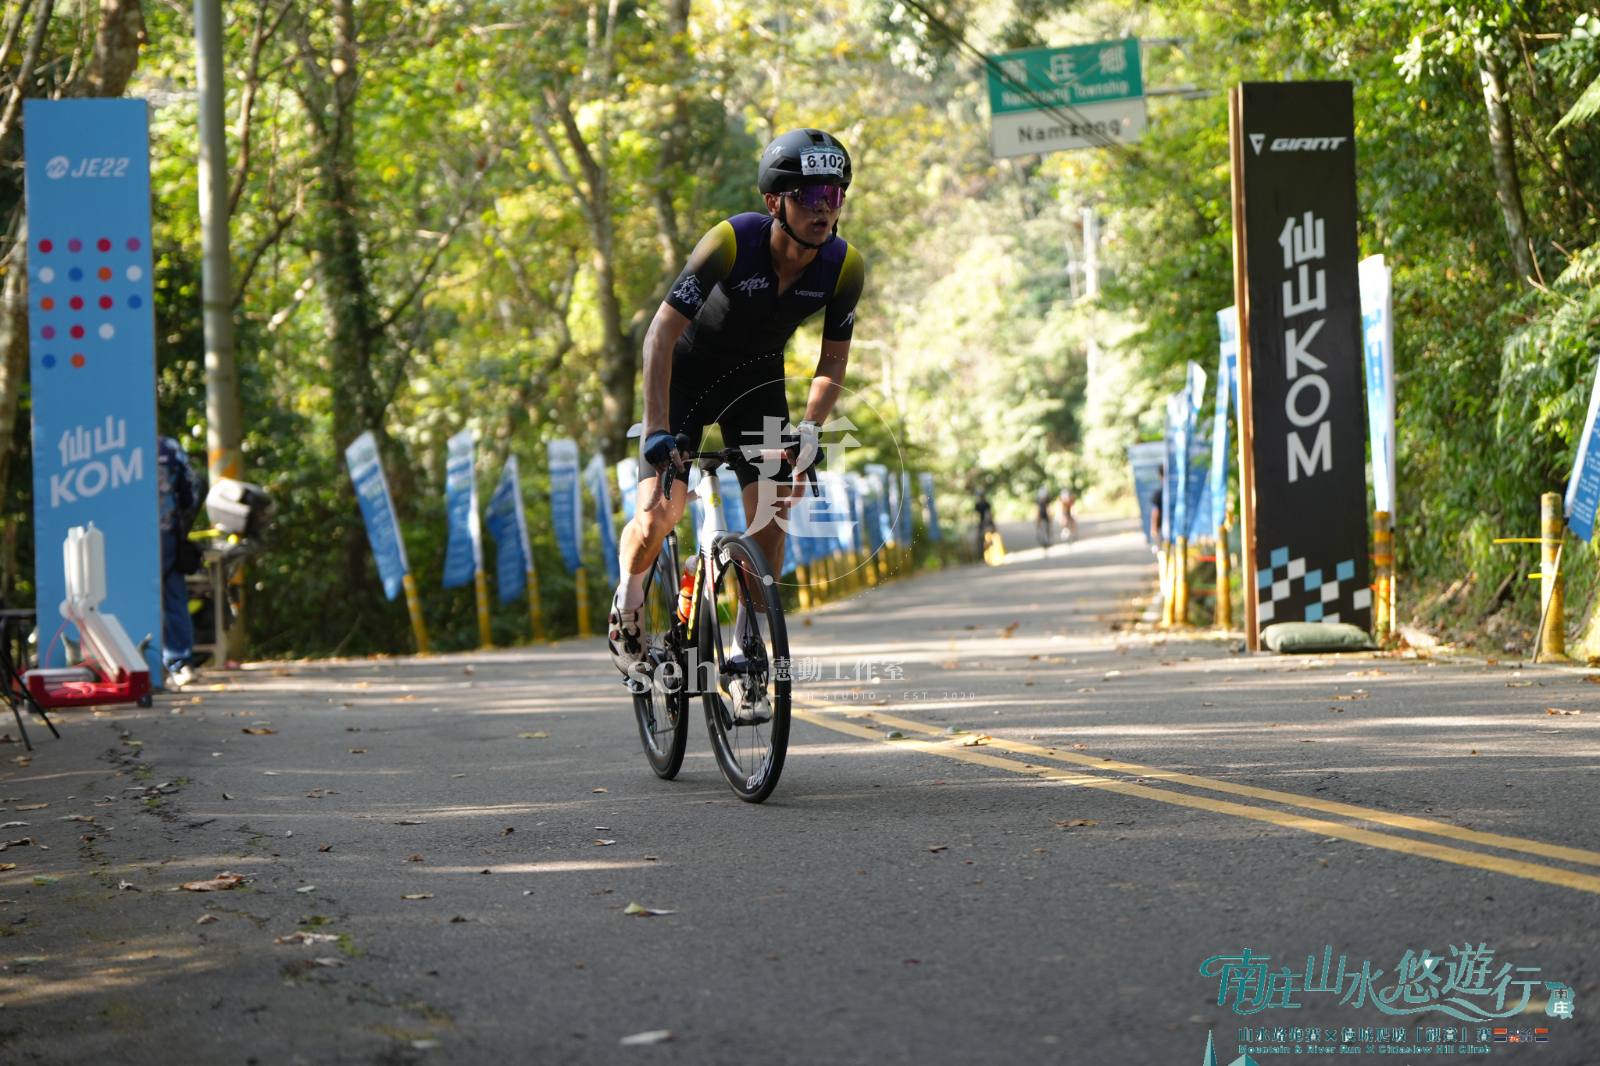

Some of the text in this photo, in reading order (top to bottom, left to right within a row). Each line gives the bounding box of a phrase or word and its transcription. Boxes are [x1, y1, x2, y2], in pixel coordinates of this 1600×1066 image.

[71, 158, 129, 178] JE22
[1270, 136, 1347, 151] GIANT
[1285, 319, 1333, 483] KOM
[57, 415, 126, 467] 仙山
[51, 448, 144, 508] KOM
